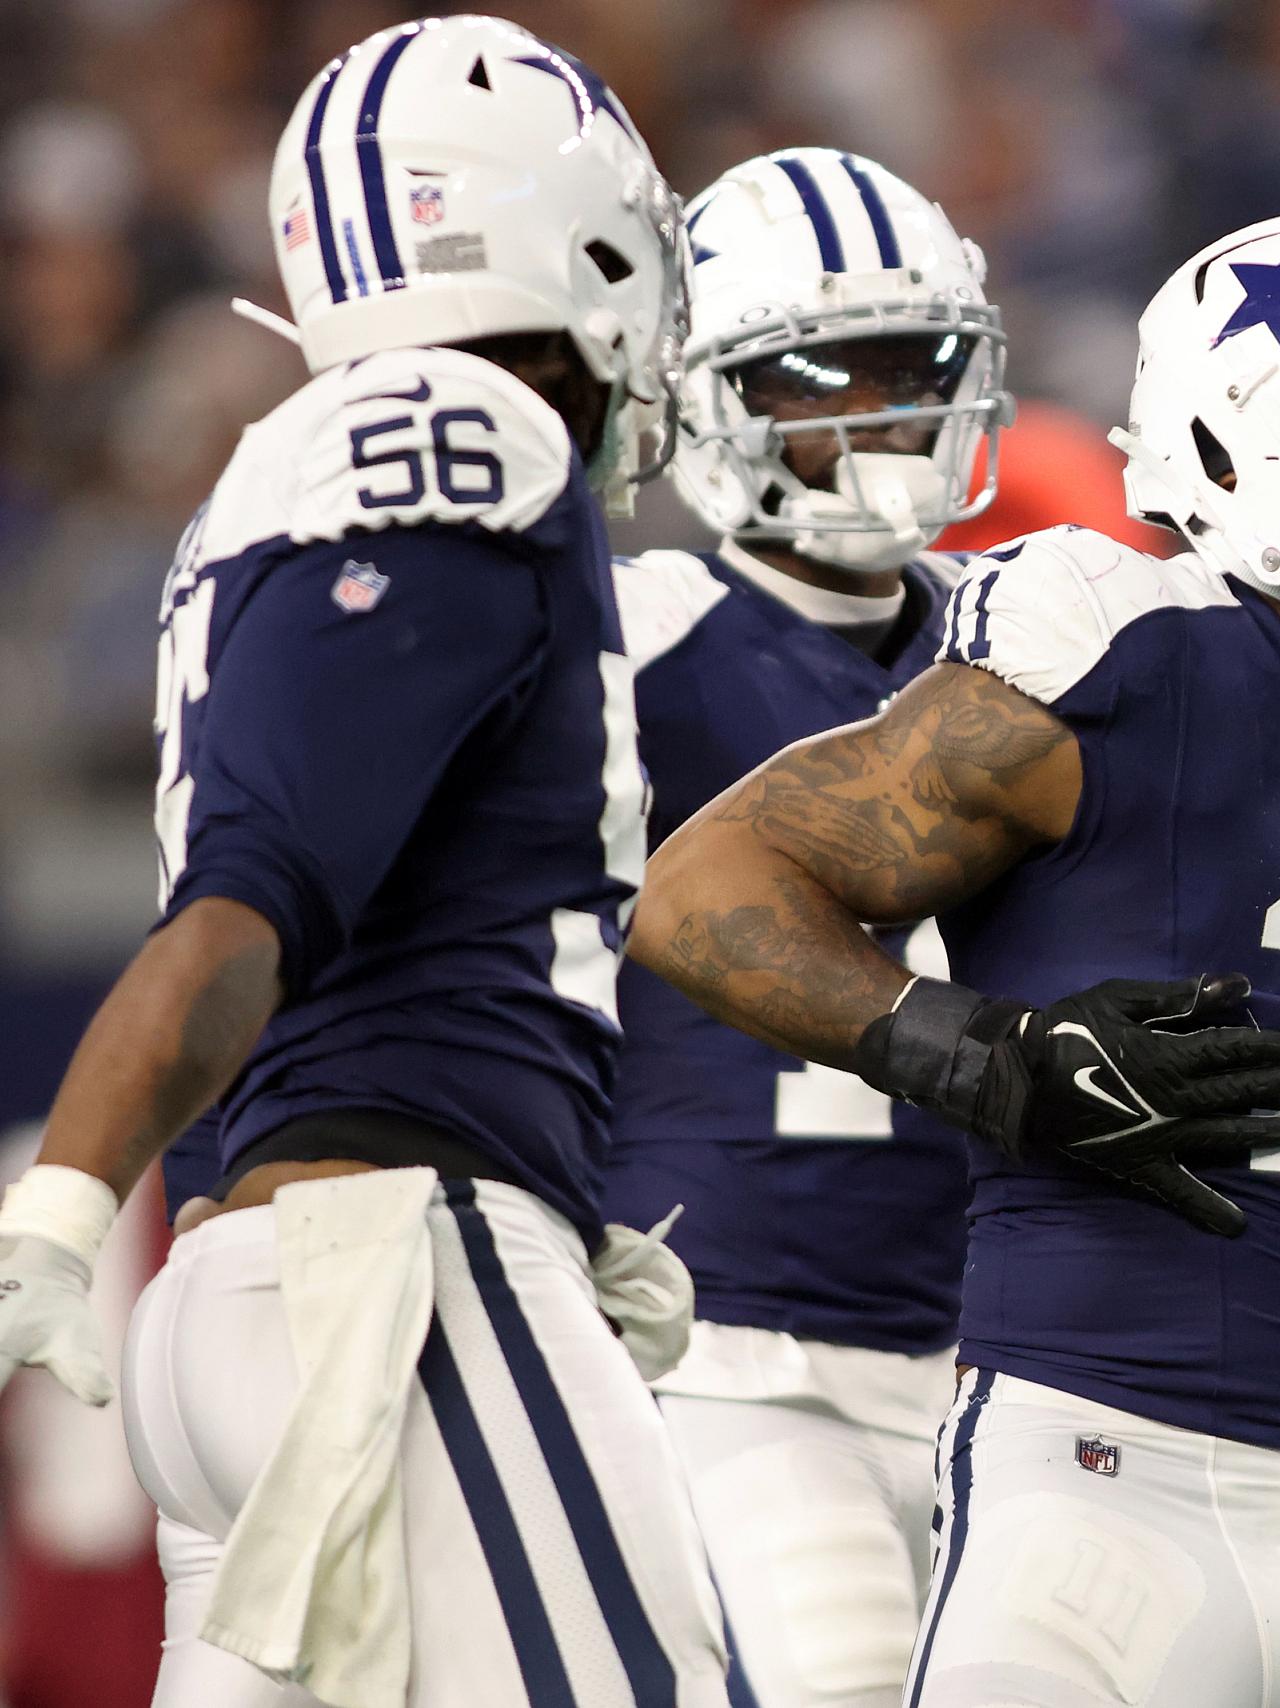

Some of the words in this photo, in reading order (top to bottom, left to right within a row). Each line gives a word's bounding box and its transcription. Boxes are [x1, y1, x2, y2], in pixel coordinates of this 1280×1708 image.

[349, 408, 504, 510] 56
[946, 569, 1001, 664] 11
[1081, 1450, 1113, 1471] NFL
